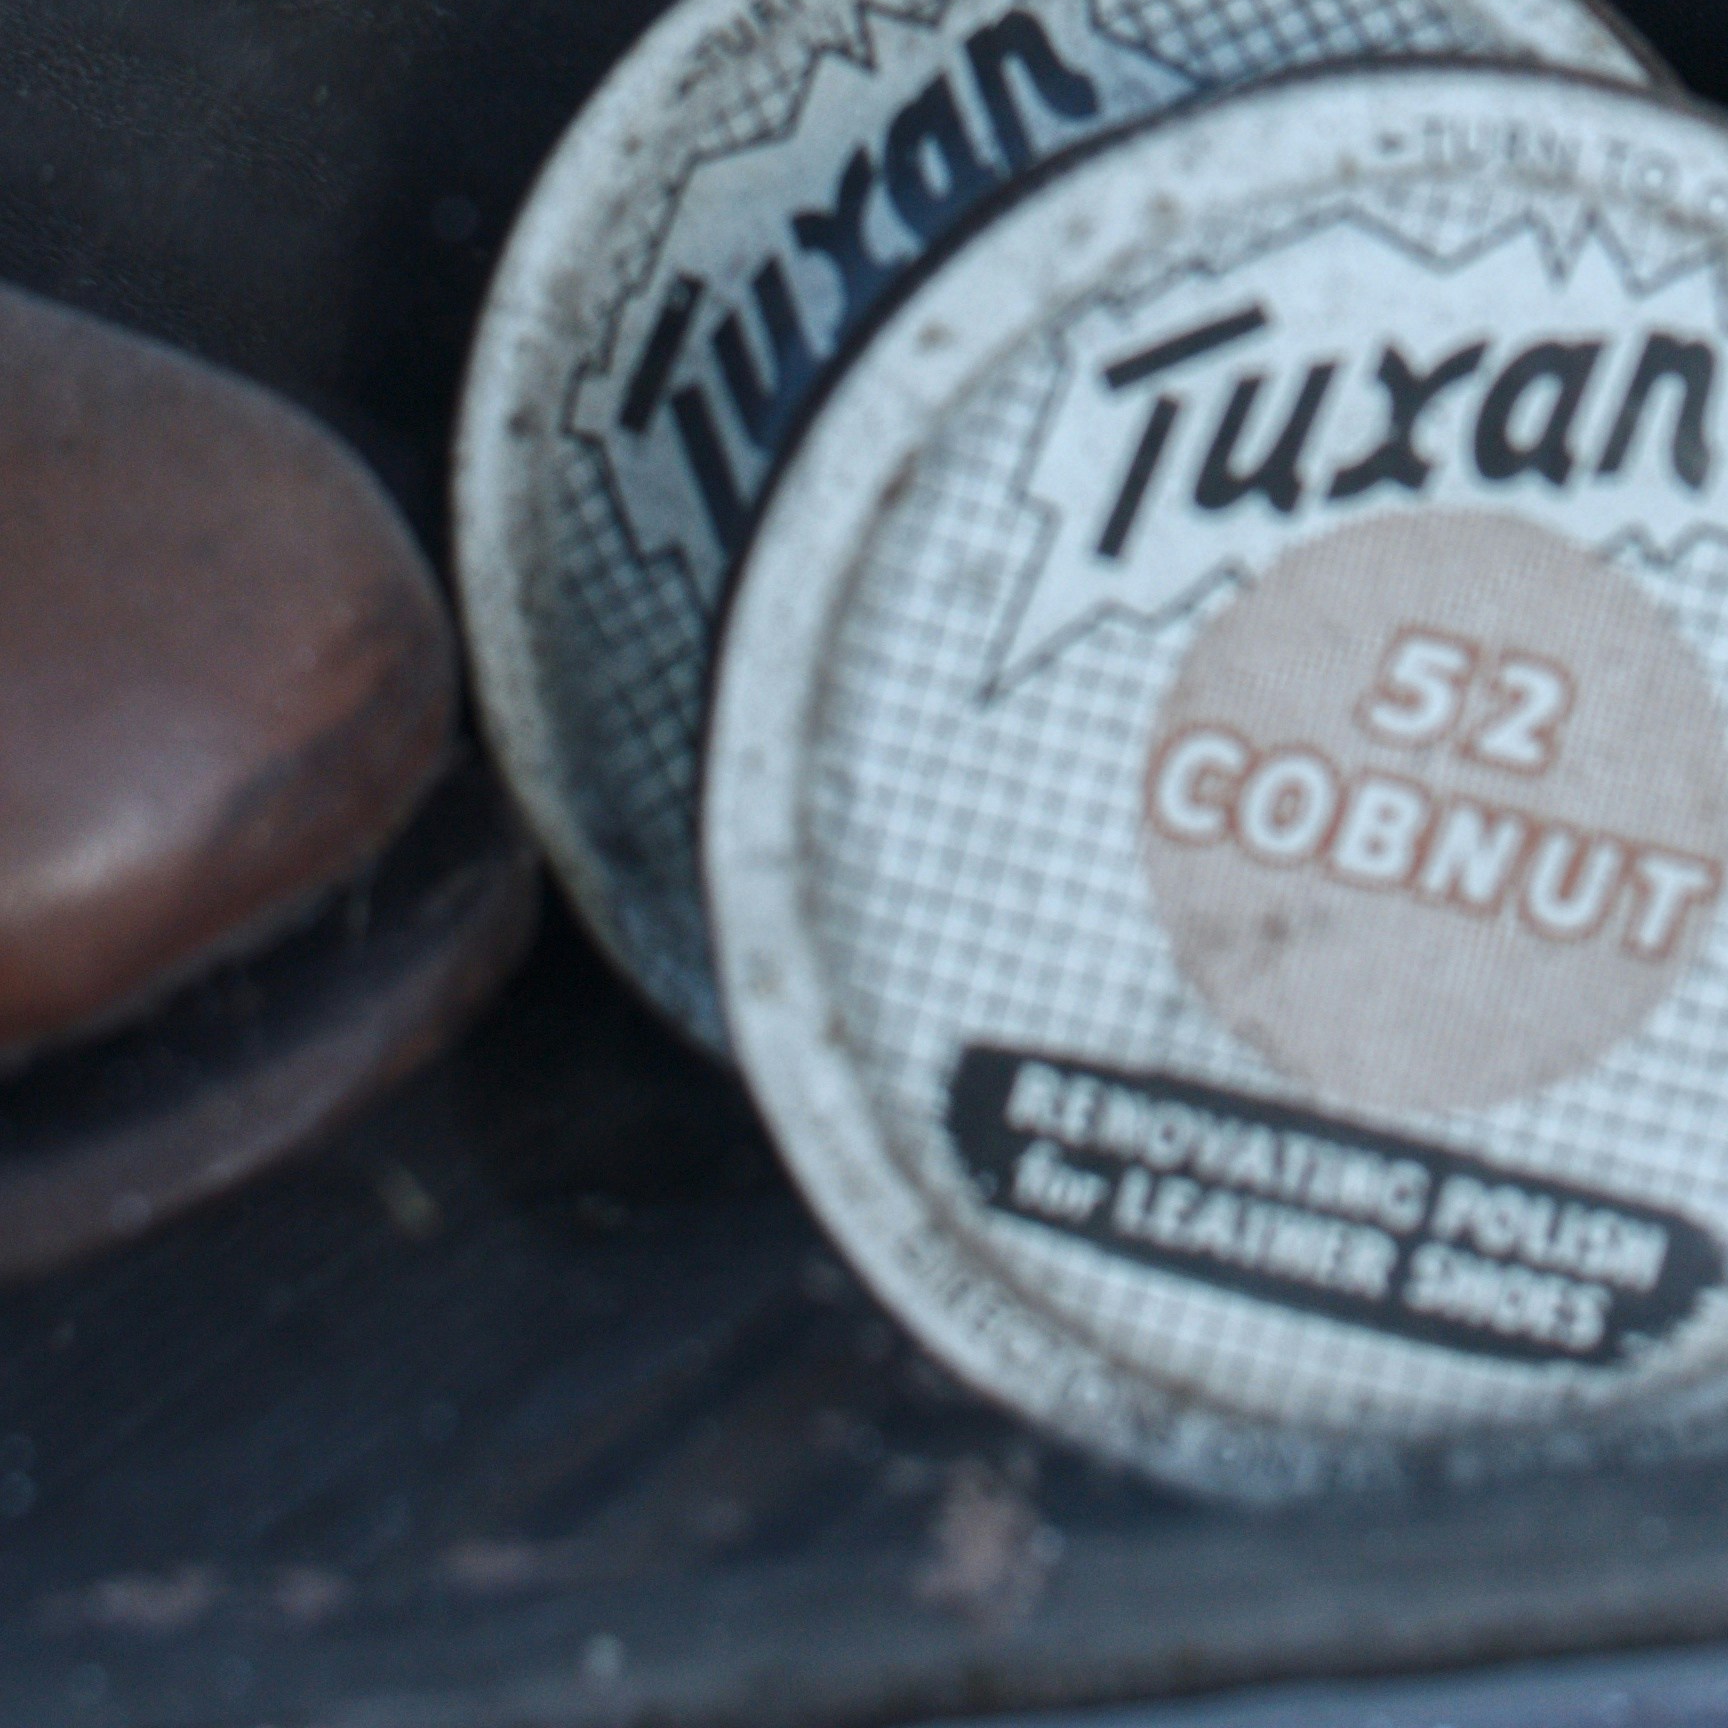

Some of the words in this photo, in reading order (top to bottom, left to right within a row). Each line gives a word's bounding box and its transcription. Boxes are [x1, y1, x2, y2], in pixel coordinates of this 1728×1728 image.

[619, 9, 1100, 556] Tuxan
[1090, 302, 1720, 562] Tuxan
[1361, 629, 1570, 774] 52
[1153, 730, 1720, 955] COBNUT
[1004, 1059, 1432, 1235] RENOVATING
[1430, 1172, 1671, 1295] POLISH
[1111, 1165, 1399, 1301] LEATHER
